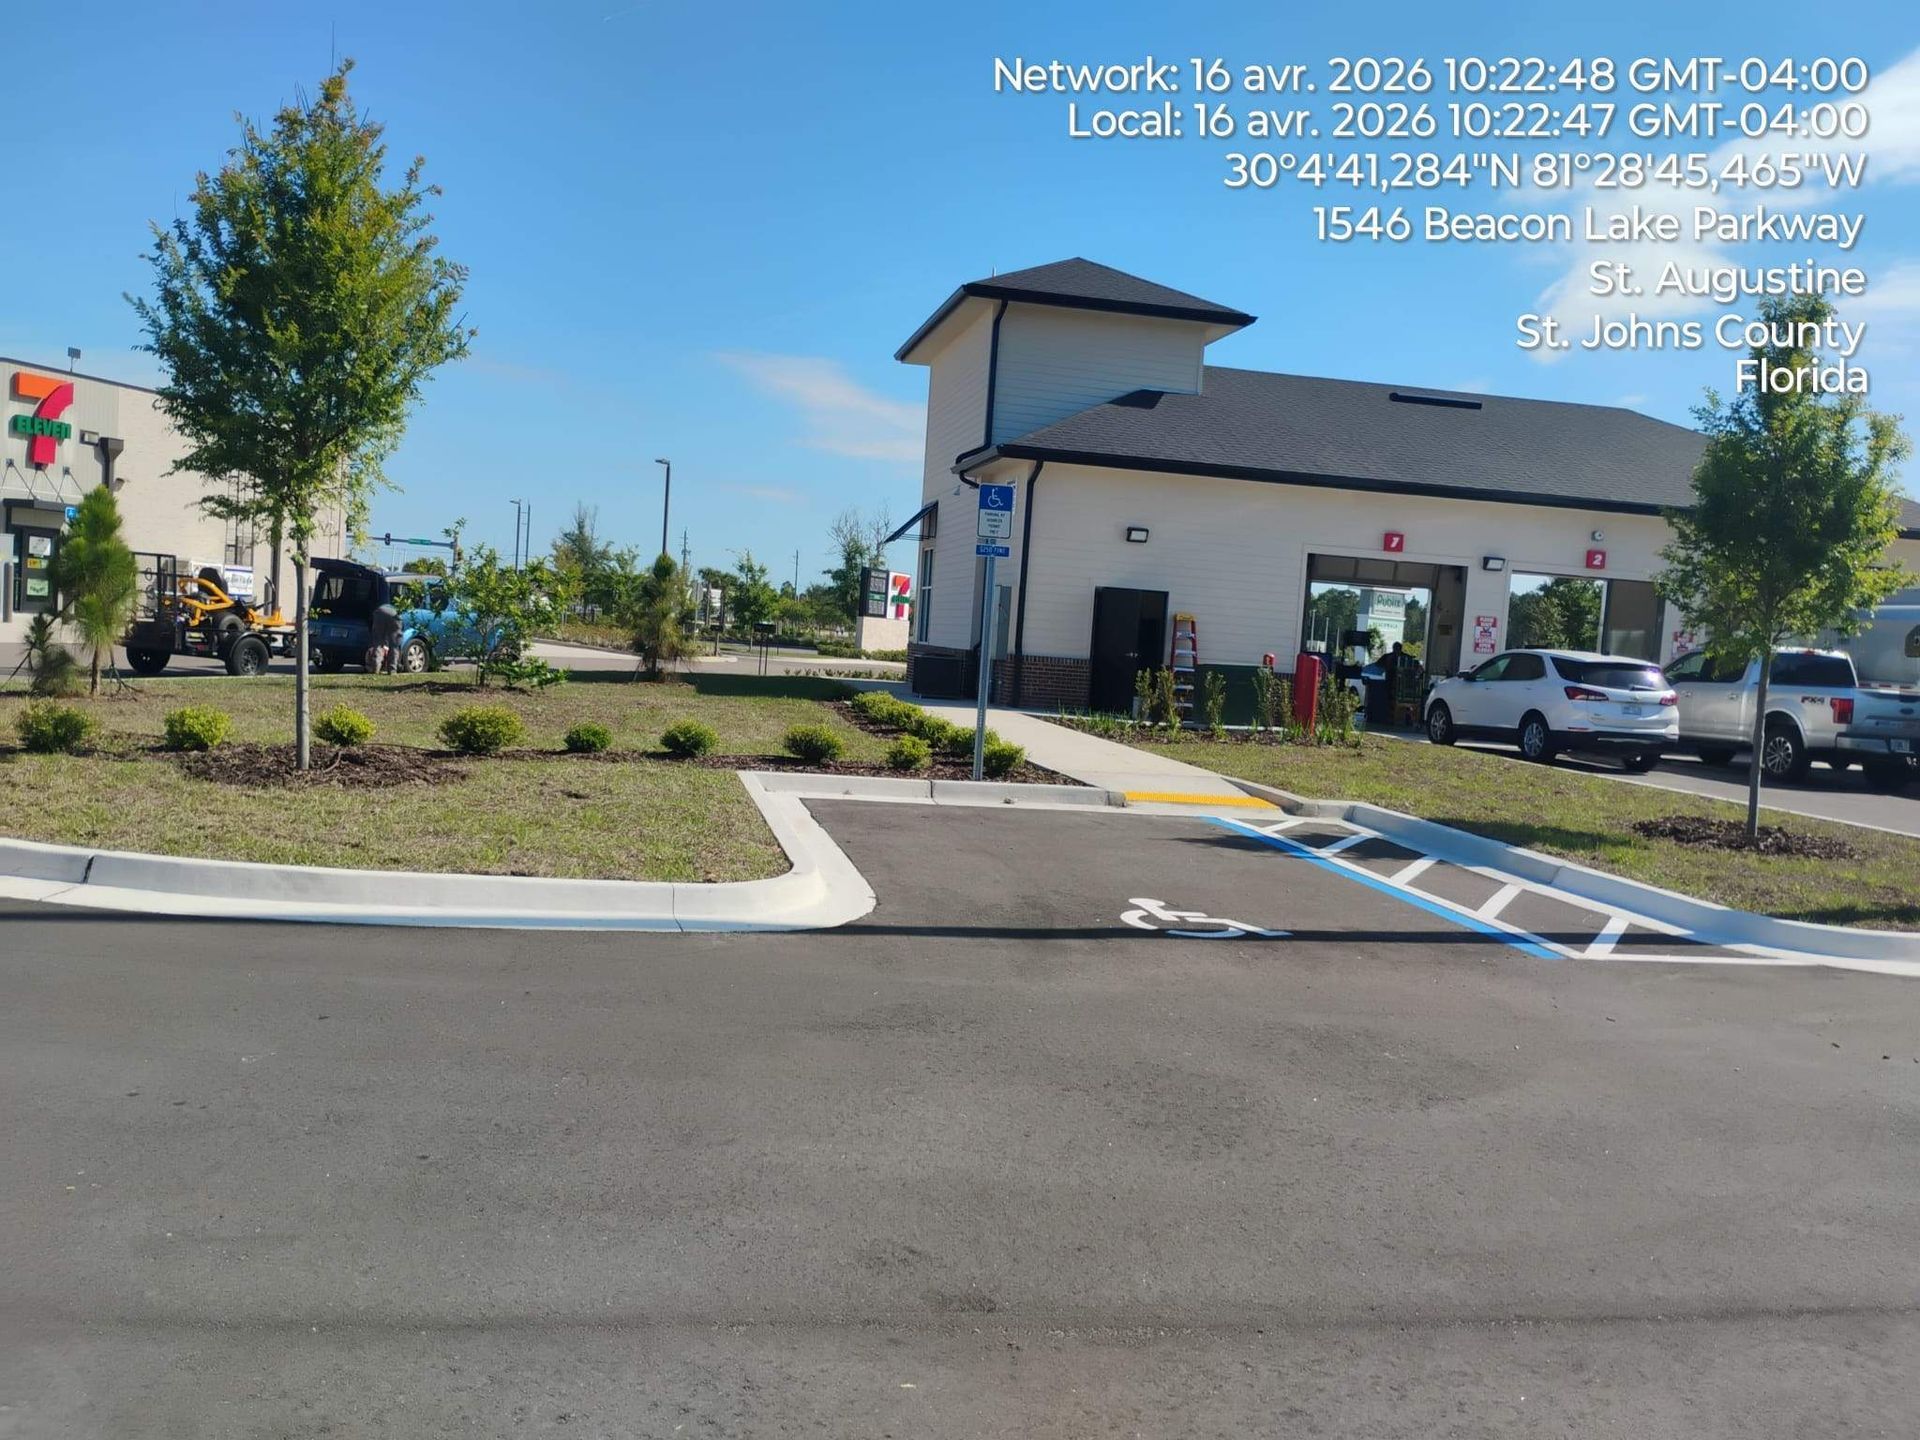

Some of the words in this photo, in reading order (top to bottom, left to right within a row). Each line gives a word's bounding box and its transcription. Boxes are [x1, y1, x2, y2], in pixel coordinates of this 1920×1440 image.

[16, 372, 74, 464] 7
[1592, 554, 1603, 566] 2
[892, 575, 911, 618] 7
